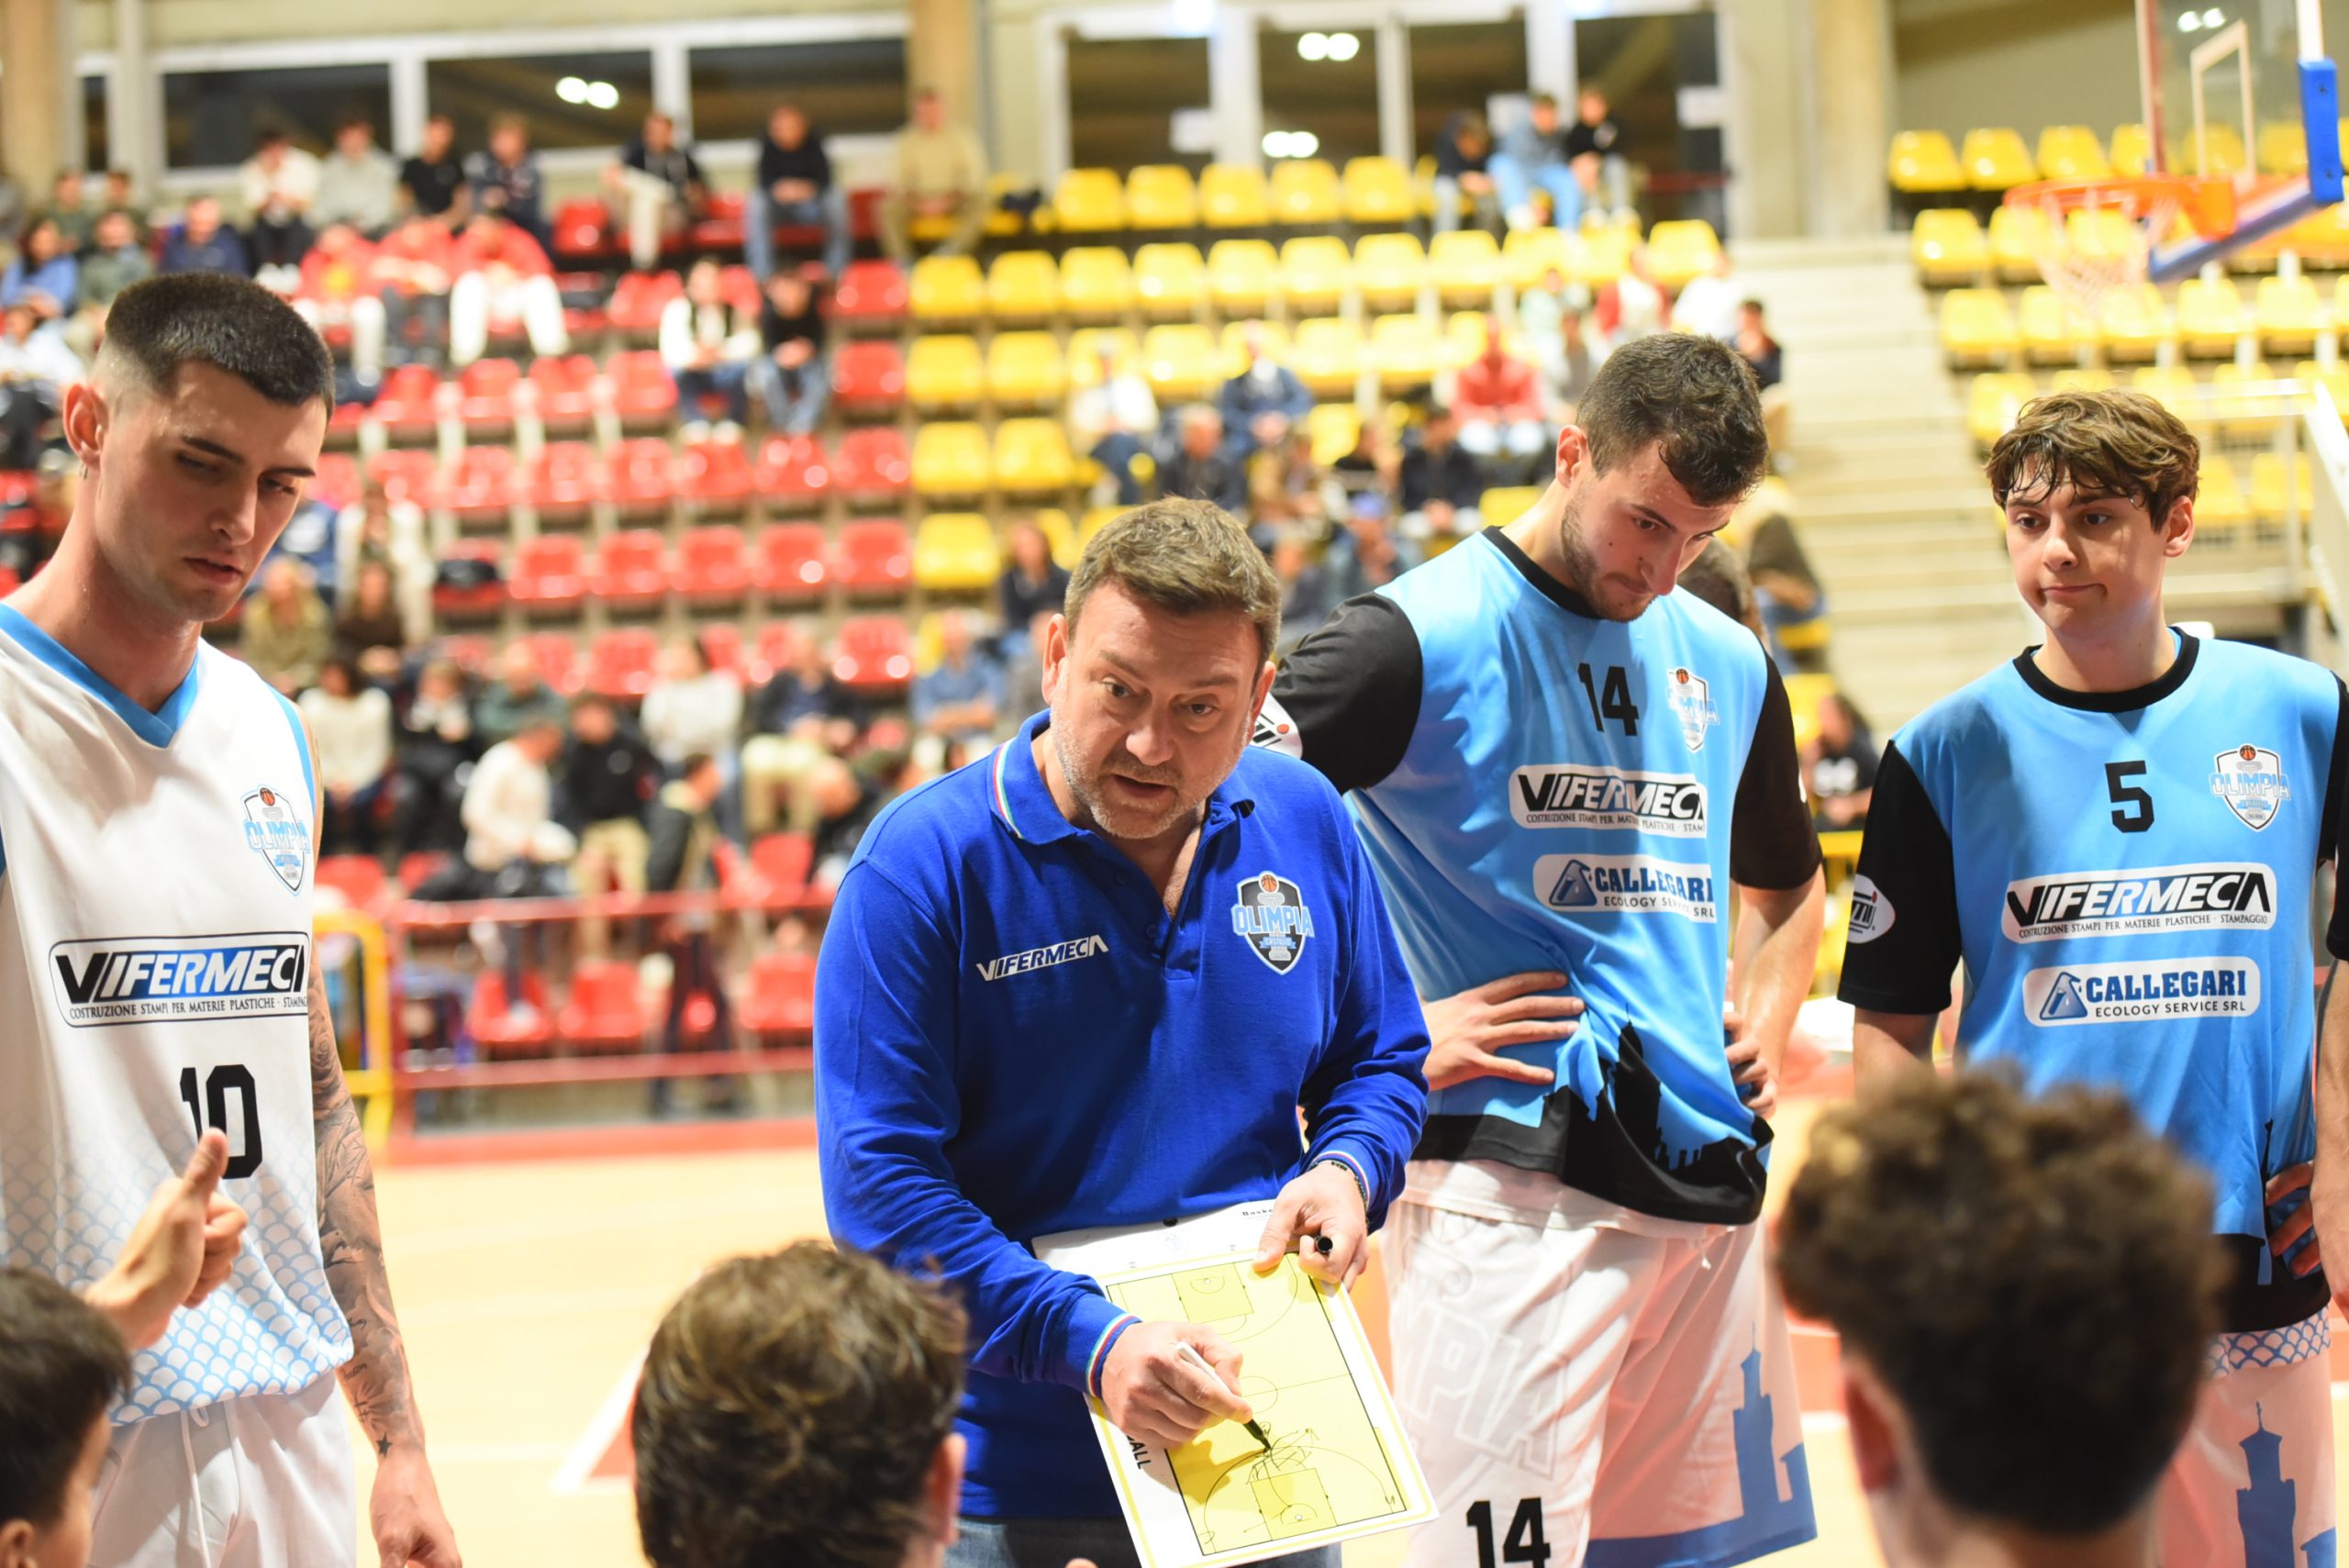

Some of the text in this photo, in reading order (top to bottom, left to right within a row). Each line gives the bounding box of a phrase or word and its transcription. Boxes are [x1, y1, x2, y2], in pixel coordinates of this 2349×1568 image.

[1578, 662, 1639, 736] 14
[2105, 760, 2154, 833] 5
[2209, 772, 2291, 800] OLIMPIA
[243, 820, 310, 854] OLIMPIA
[1599, 815, 1614, 825] PER
[1595, 867, 1714, 902] CALLEGARI
[2007, 873, 2271, 927] VIFERMECA
[1230, 904, 1315, 939] OLIMPIA
[1604, 896, 1657, 908] ECOLOGY
[1693, 906, 1715, 917] SRL
[2019, 913, 2268, 940] COSTRUZIONE STAMPI PER MATERIE PLASTICHE STAMPAGGIO
[976, 934, 1109, 982] VIFERMECA
[2086, 970, 2246, 1003] CALLEGARI
[69, 1000, 137, 1020] COSTRUZIONE
[140, 1002, 169, 1015] STAMPI
[172, 1001, 185, 1014] PER
[188, 999, 226, 1013] MATERIE
[229, 997, 275, 1011] PLASTICHE
[2095, 1001, 2246, 1018] ECOLOGY SERVICE SRL
[180, 1064, 262, 1180] 10
[1466, 1496, 1551, 1568] 14
